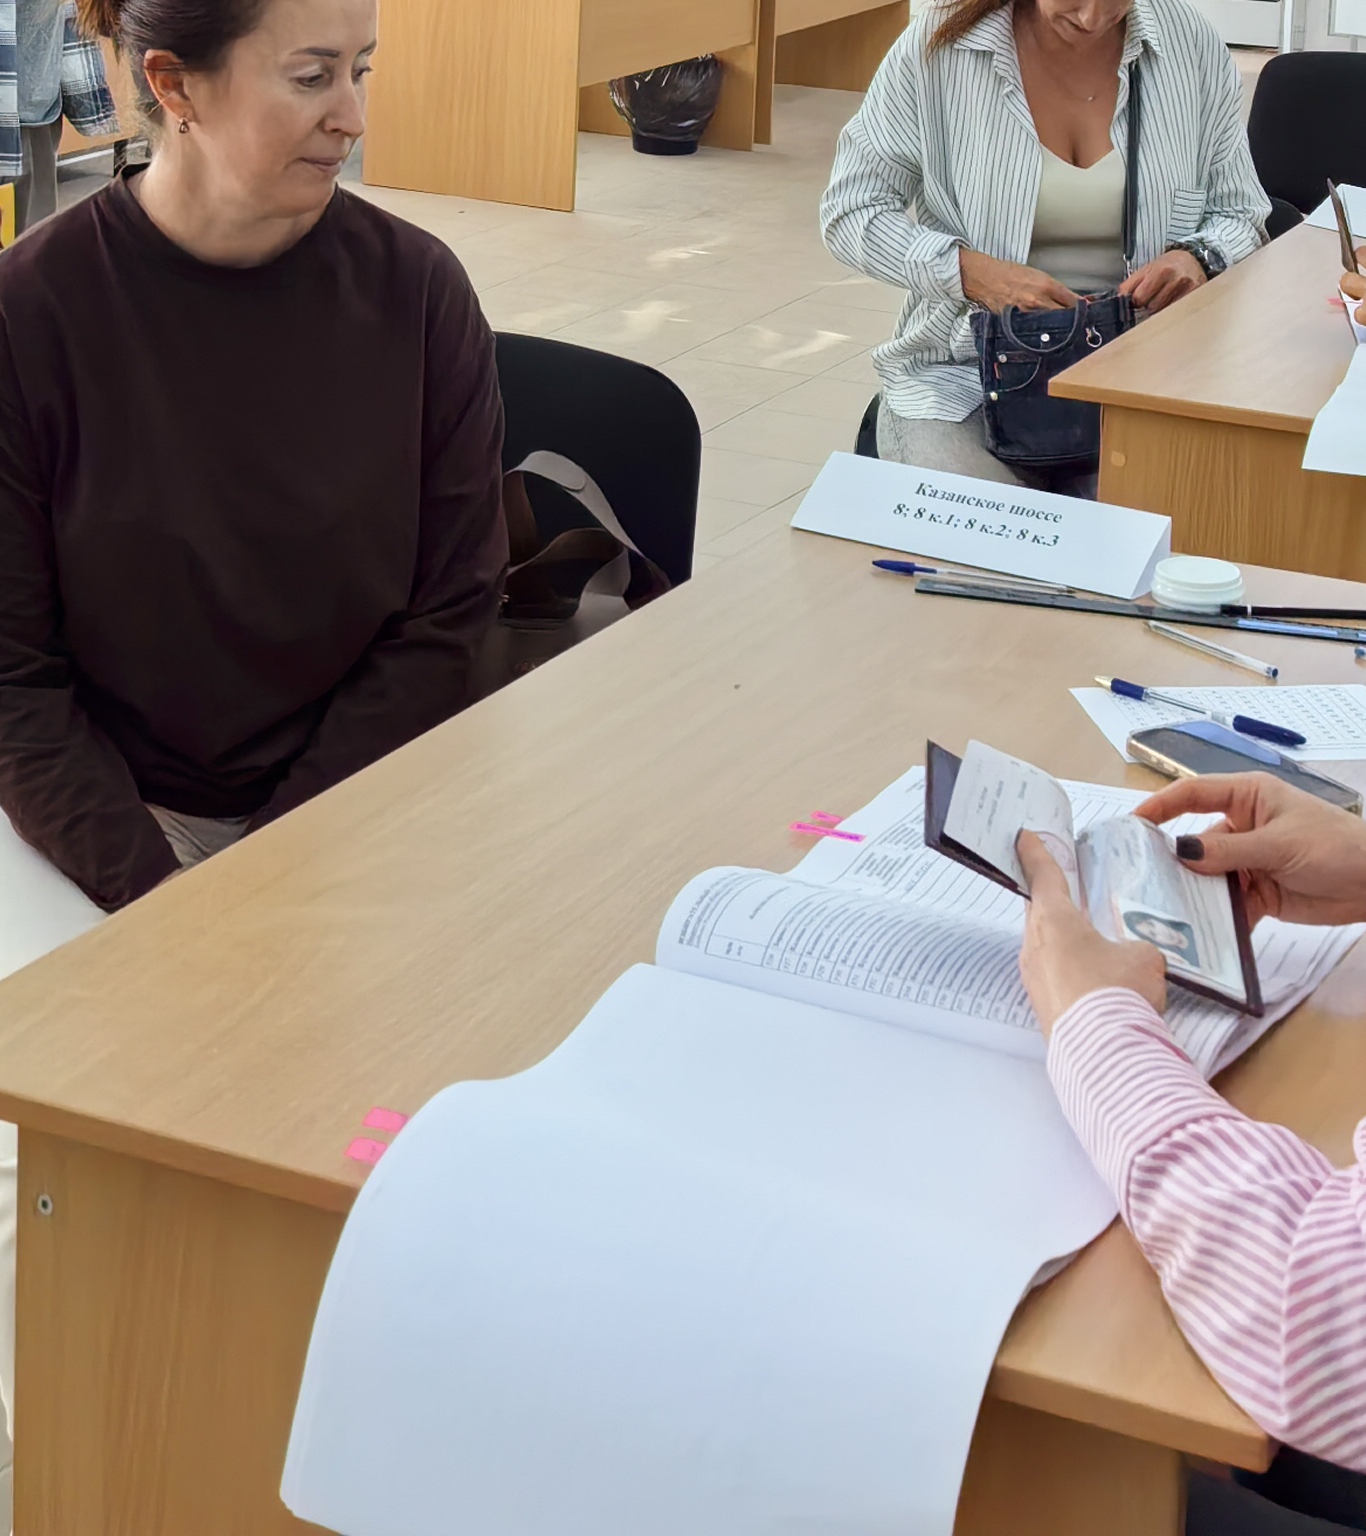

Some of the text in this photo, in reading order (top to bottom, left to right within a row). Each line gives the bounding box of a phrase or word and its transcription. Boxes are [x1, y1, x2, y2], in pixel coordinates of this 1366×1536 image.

[892, 502, 1060, 548] 8; 8 к.1; 8 к.2; 8 к.3
[914, 482, 1064, 524] Казанское шоссе
